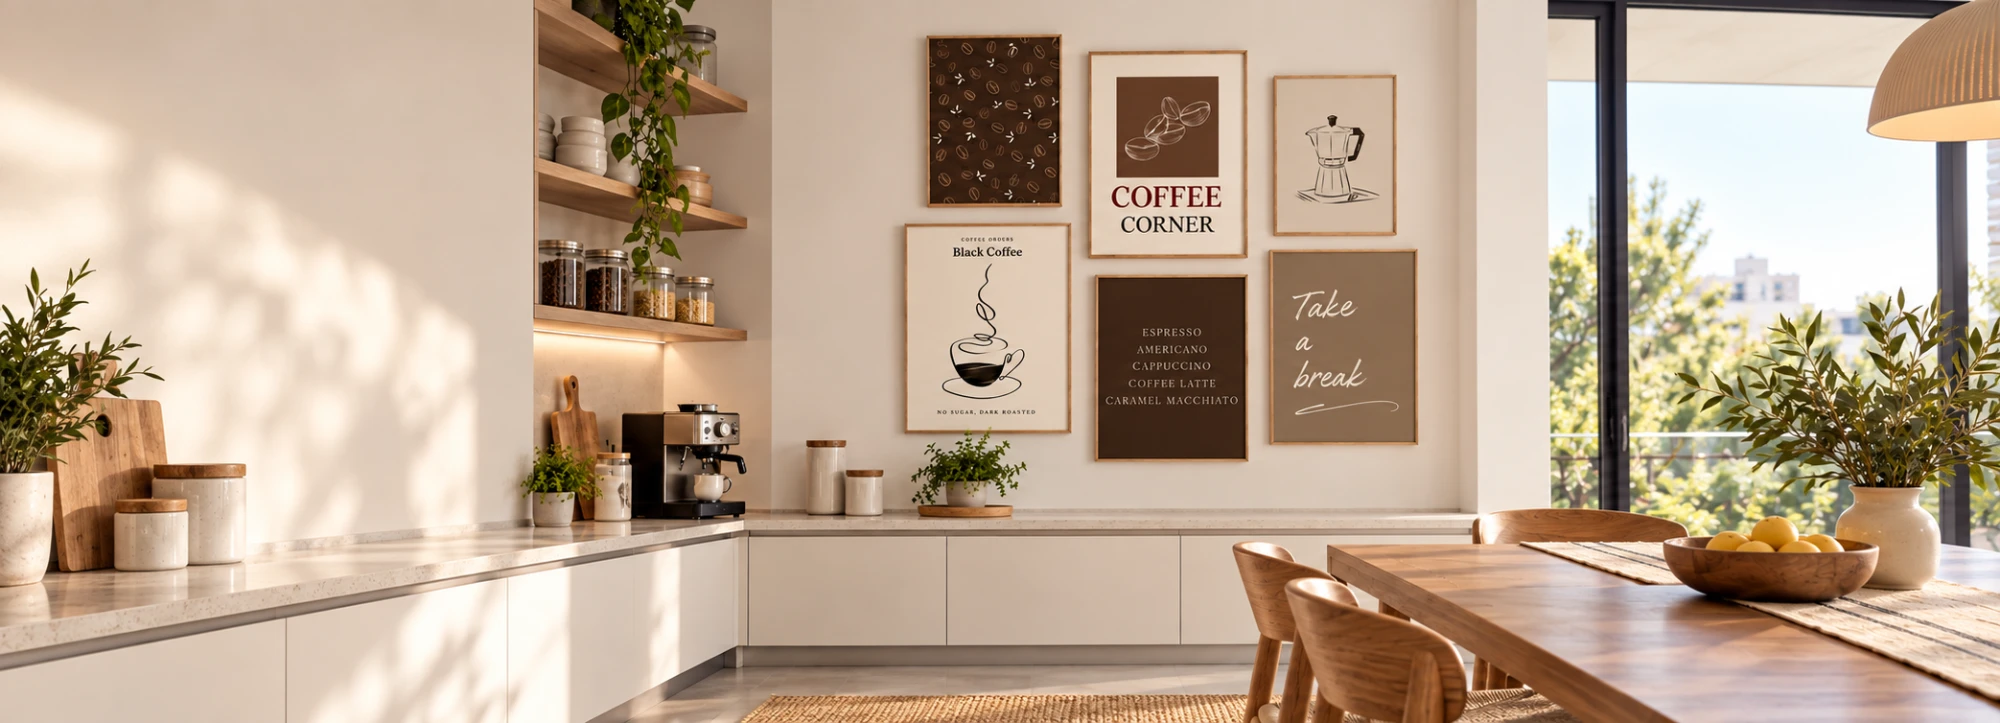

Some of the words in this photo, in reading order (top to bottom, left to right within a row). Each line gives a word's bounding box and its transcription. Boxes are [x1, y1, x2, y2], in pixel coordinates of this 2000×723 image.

[1111, 185, 1222, 208] COFFEE
[1121, 215, 1215, 233] CORNER
[952, 246, 984, 257] Black
[986, 246, 1023, 257] Coffee
[1292, 289, 1358, 321] Take
[1142, 327, 1202, 337] ESPRESSO
[1295, 336, 1313, 351] a
[1136, 345, 1208, 354] AMERICANO
[1131, 361, 1211, 371] CAPPUCCINO
[1293, 358, 1367, 388] break
[1128, 379, 1175, 388] COFFEE
[1180, 379, 1216, 388] LATTE
[1105, 396, 1162, 405] CARAMEL
[1166, 396, 1239, 405] MACCHIATO
